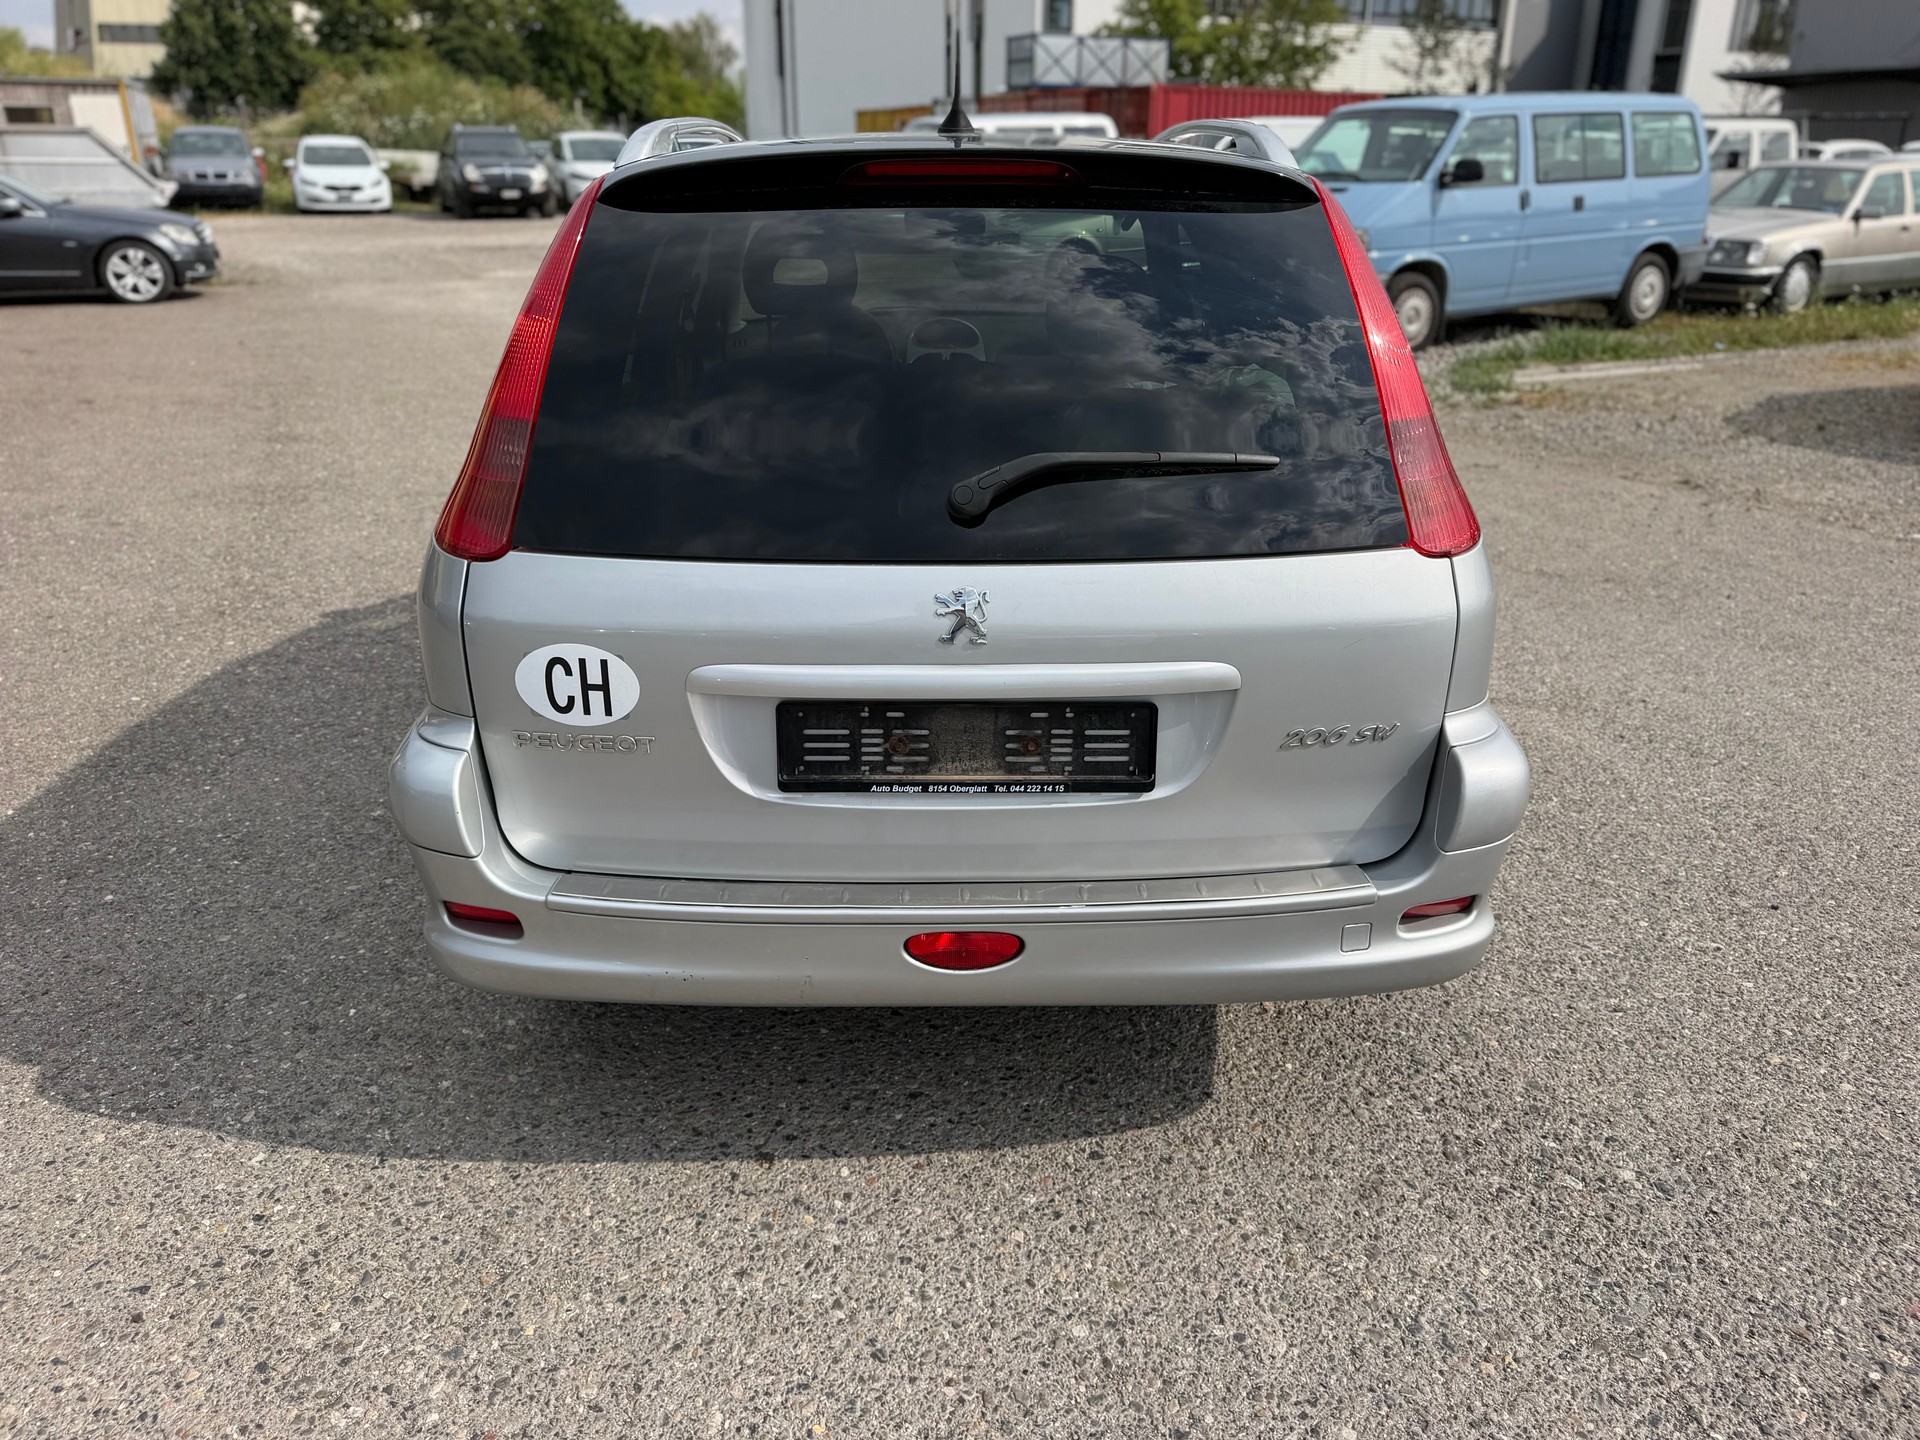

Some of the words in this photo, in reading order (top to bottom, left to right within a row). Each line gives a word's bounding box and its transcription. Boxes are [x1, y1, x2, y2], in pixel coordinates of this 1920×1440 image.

[544, 656, 613, 717] CH
[511, 730, 656, 754] PEUGEOT
[1279, 723, 1350, 749] 206
[1348, 721, 1400, 745] SW
[870, 784, 891, 793] Auto
[892, 784, 922, 794] Budget
[928, 784, 948, 793] 8154
[949, 784, 988, 794] Oberglatt
[994, 784, 1008, 793] Tel.
[1009, 784, 1025, 793] 044
[1026, 784, 1041, 793] 222
[1043, 784, 1053, 793] 14
[1054, 784, 1065, 793] 15
